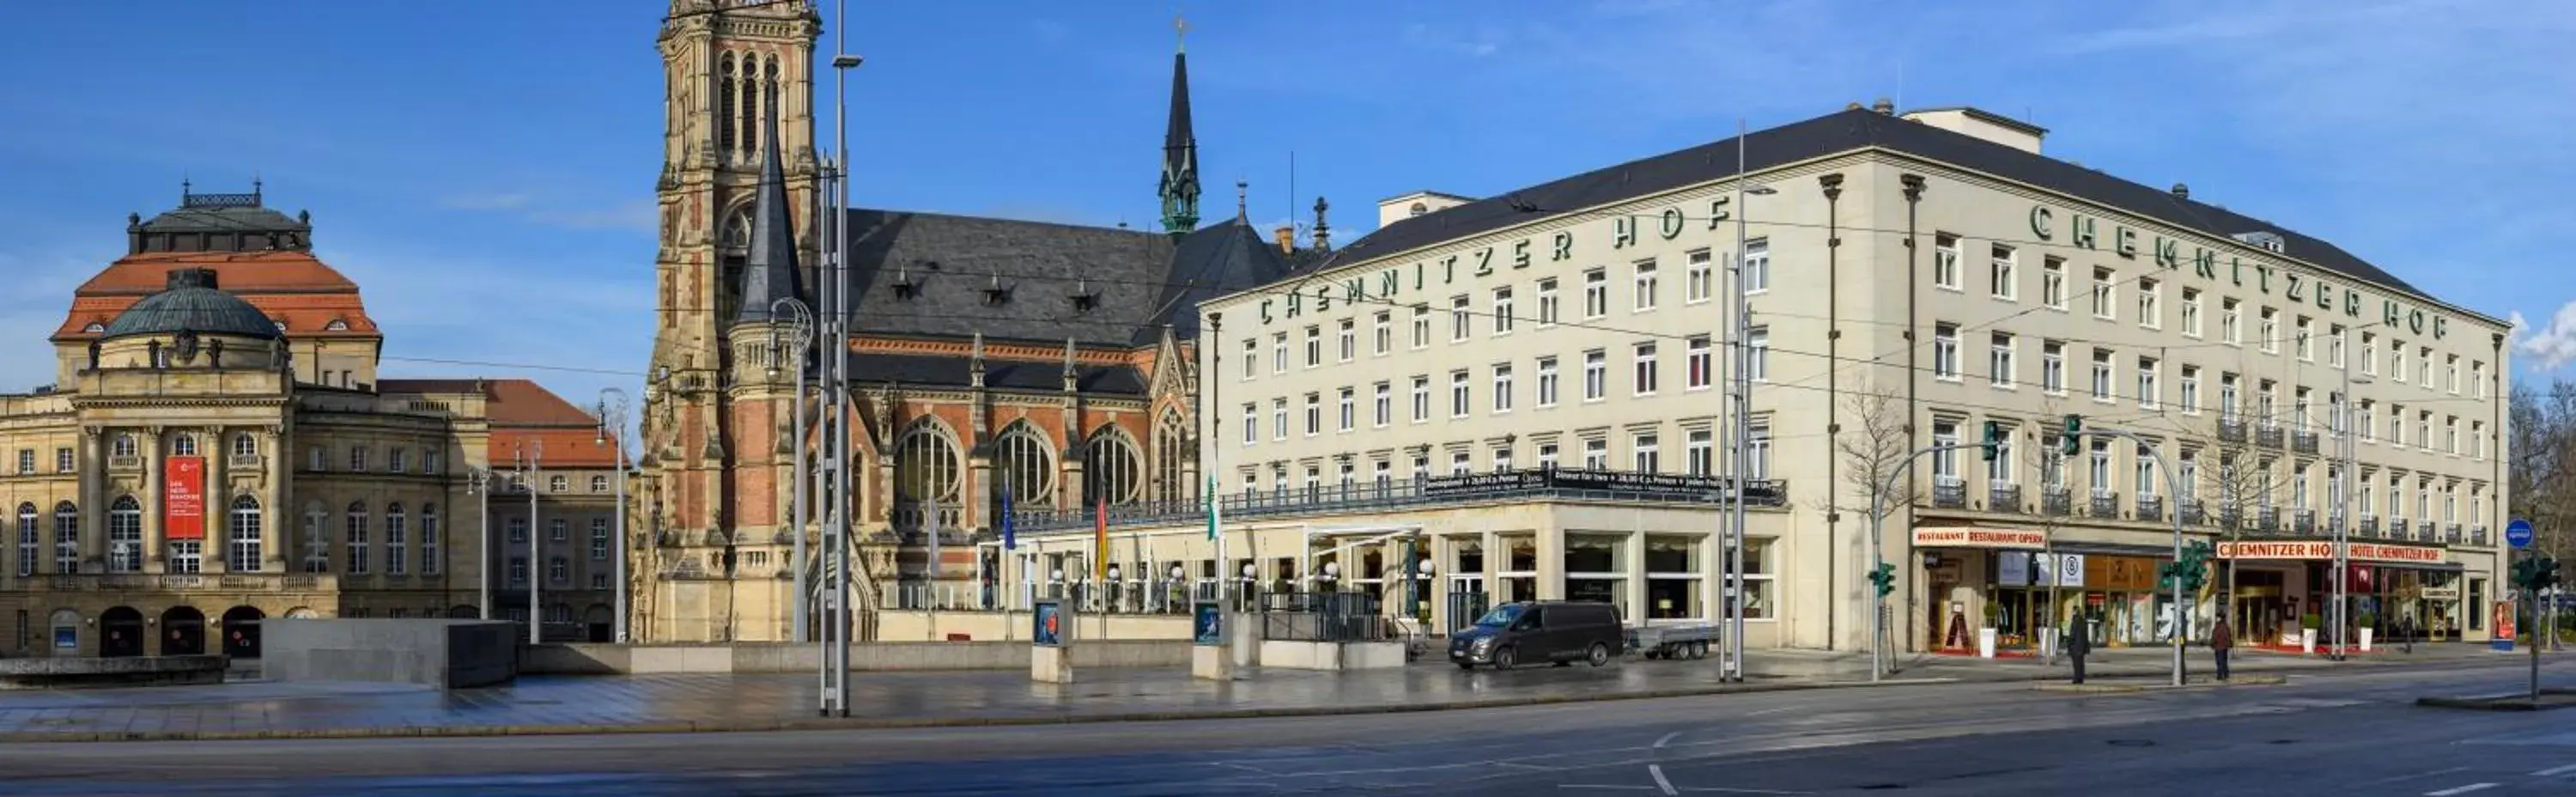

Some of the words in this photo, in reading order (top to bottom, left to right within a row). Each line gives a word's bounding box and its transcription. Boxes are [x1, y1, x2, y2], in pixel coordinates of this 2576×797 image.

[1261, 230, 1572, 325] CHEMNITZER
[1613, 196, 1729, 249] HOF
[2030, 204, 2361, 319] CHEMNITZER
[2384, 300, 2447, 340] HOF
[1917, 531, 1965, 541] RESTAURANT
[1969, 531, 2018, 543] RESTAURANT
[2311, 544, 2334, 557] HO
[2350, 545, 2374, 557] HOTEL
[2377, 546, 2421, 559] CHEMNITZER
